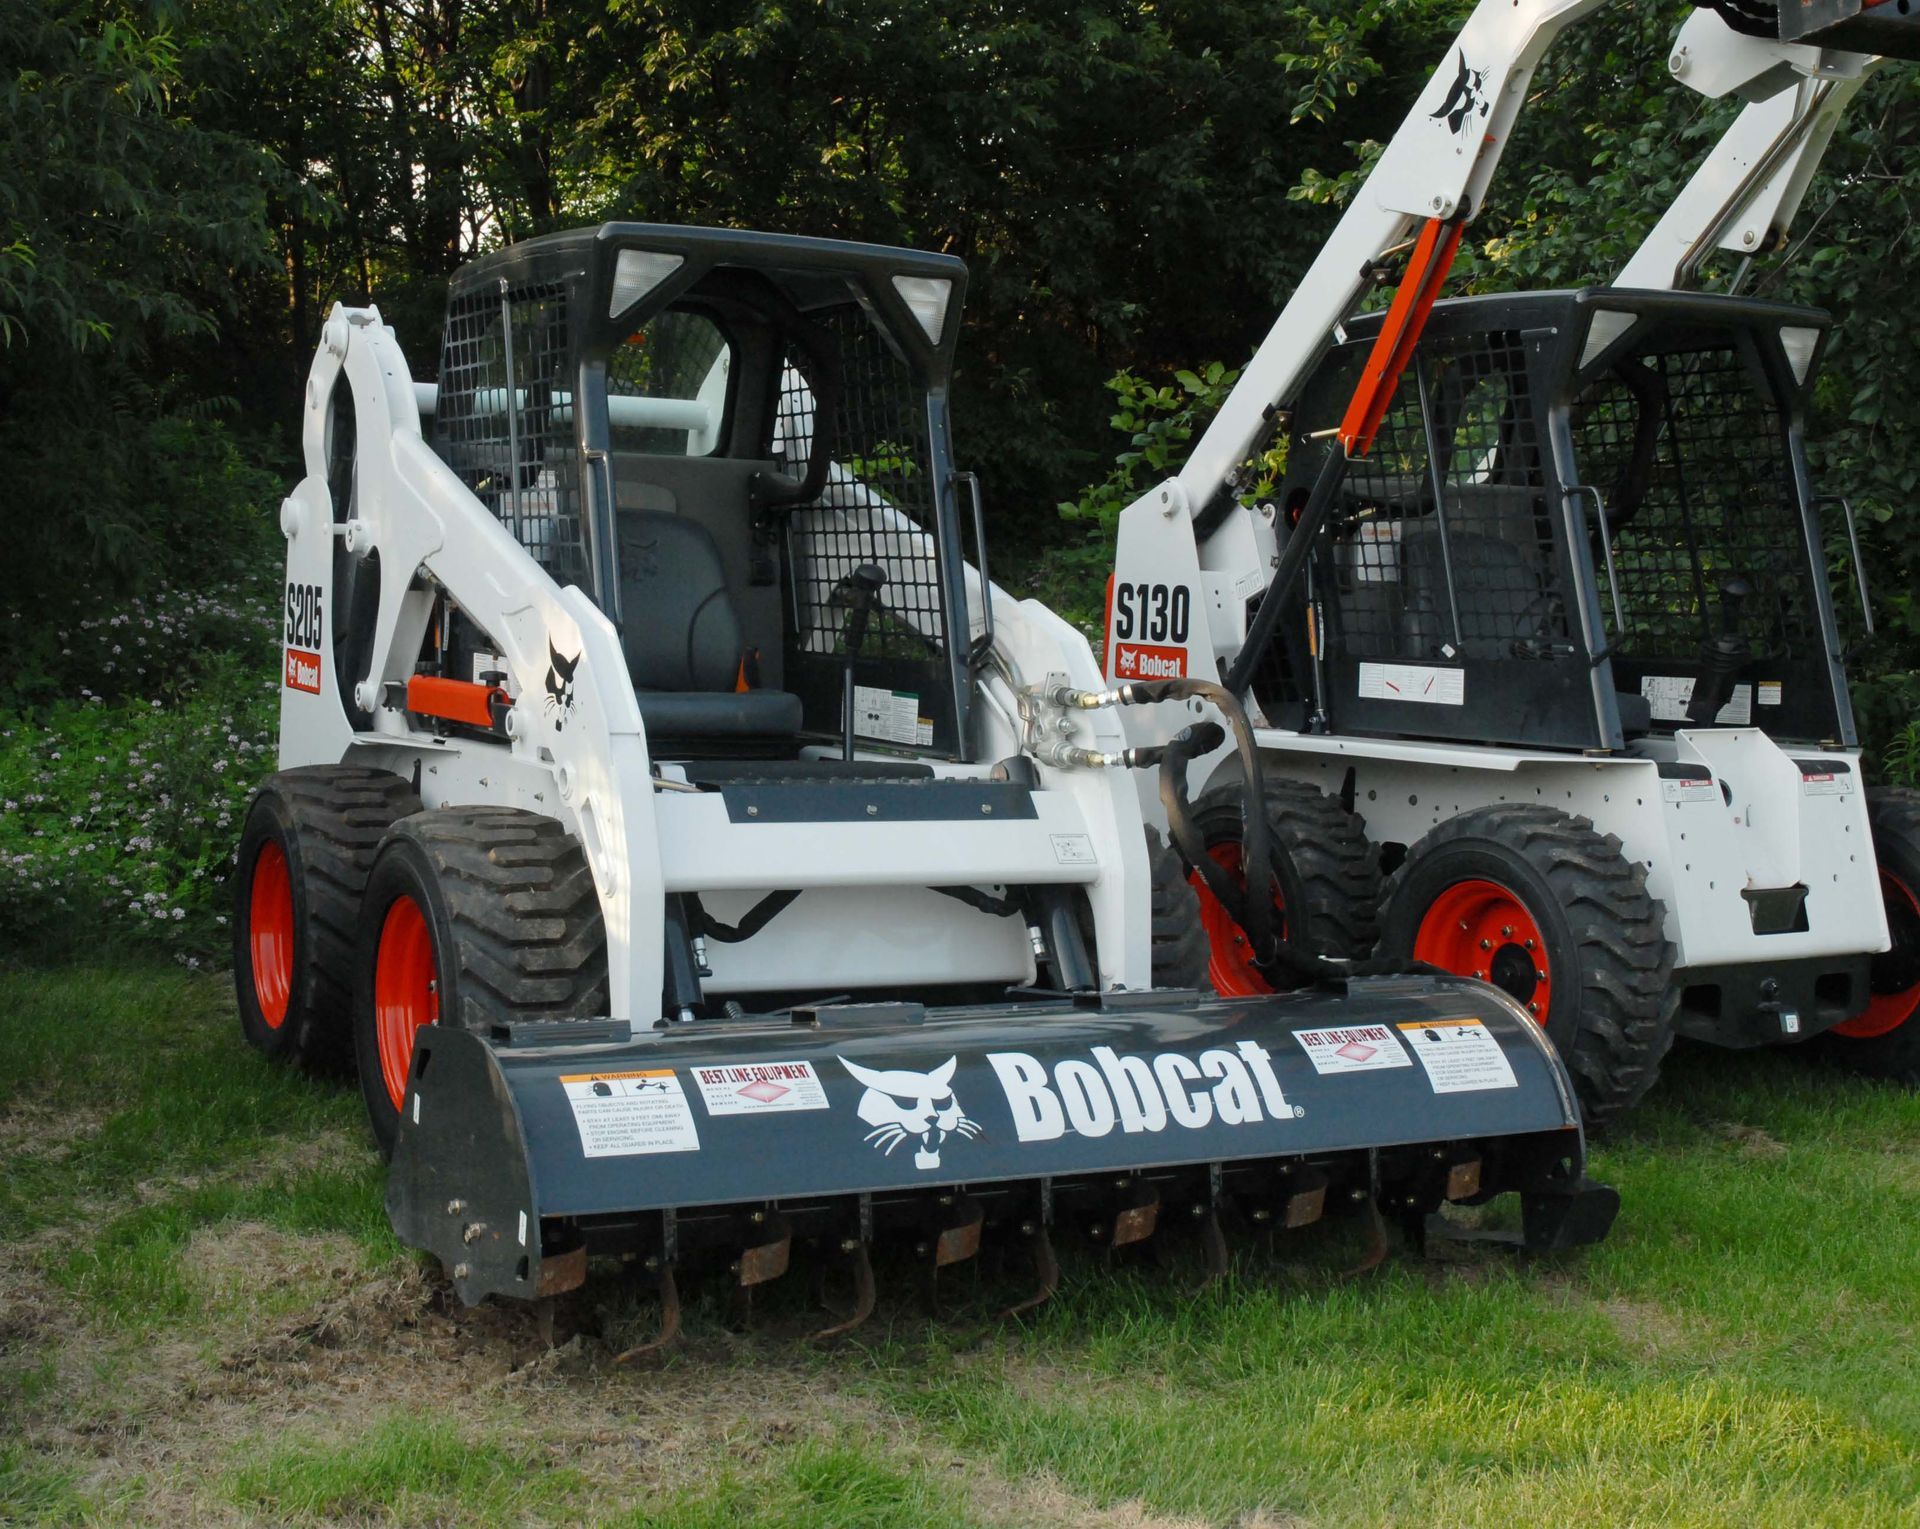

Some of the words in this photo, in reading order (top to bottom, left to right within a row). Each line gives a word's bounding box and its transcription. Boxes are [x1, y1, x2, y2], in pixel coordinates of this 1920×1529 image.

[287, 583, 322, 650] S205
[1116, 583, 1190, 643] S130
[1139, 653, 1181, 678] Bobcat
[1300, 1033, 1325, 1046] BEST
[1322, 1031, 1344, 1045] LINE
[1341, 1027, 1390, 1042] EQUIPMENT
[601, 1072, 647, 1080] WARNING
[699, 1070, 727, 1084] BEST
[726, 1068, 753, 1083] LINE
[752, 1064, 810, 1081] EQUIPMENT
[985, 1041, 1295, 1142] Bobcat
